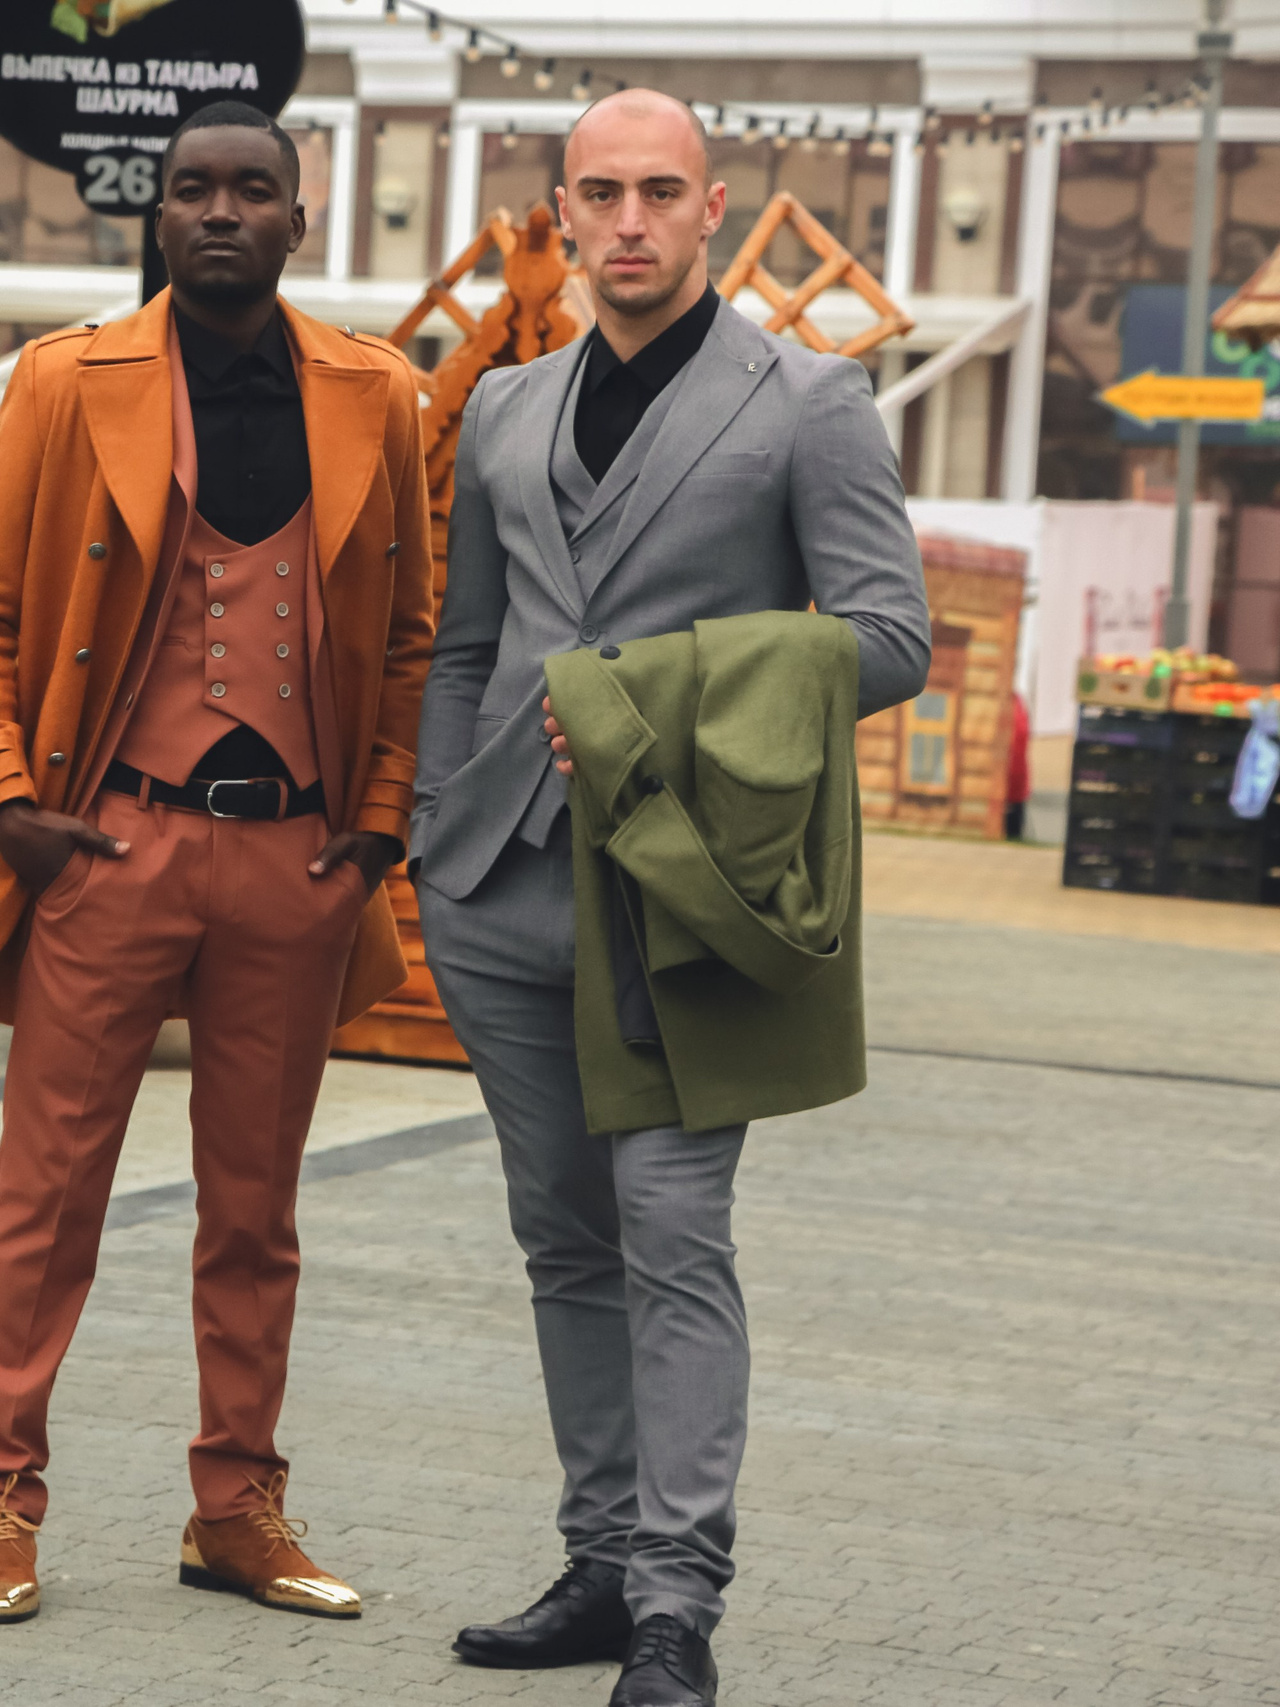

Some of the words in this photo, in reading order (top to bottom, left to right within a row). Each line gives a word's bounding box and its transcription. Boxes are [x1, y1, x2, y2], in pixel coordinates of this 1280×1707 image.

[1, 54, 111, 82] ВЫПЕЧКА
[144, 60, 258, 91] ТАНДЫРА
[76, 87, 178, 117] ШАУРМА
[84, 155, 156, 204] 26
